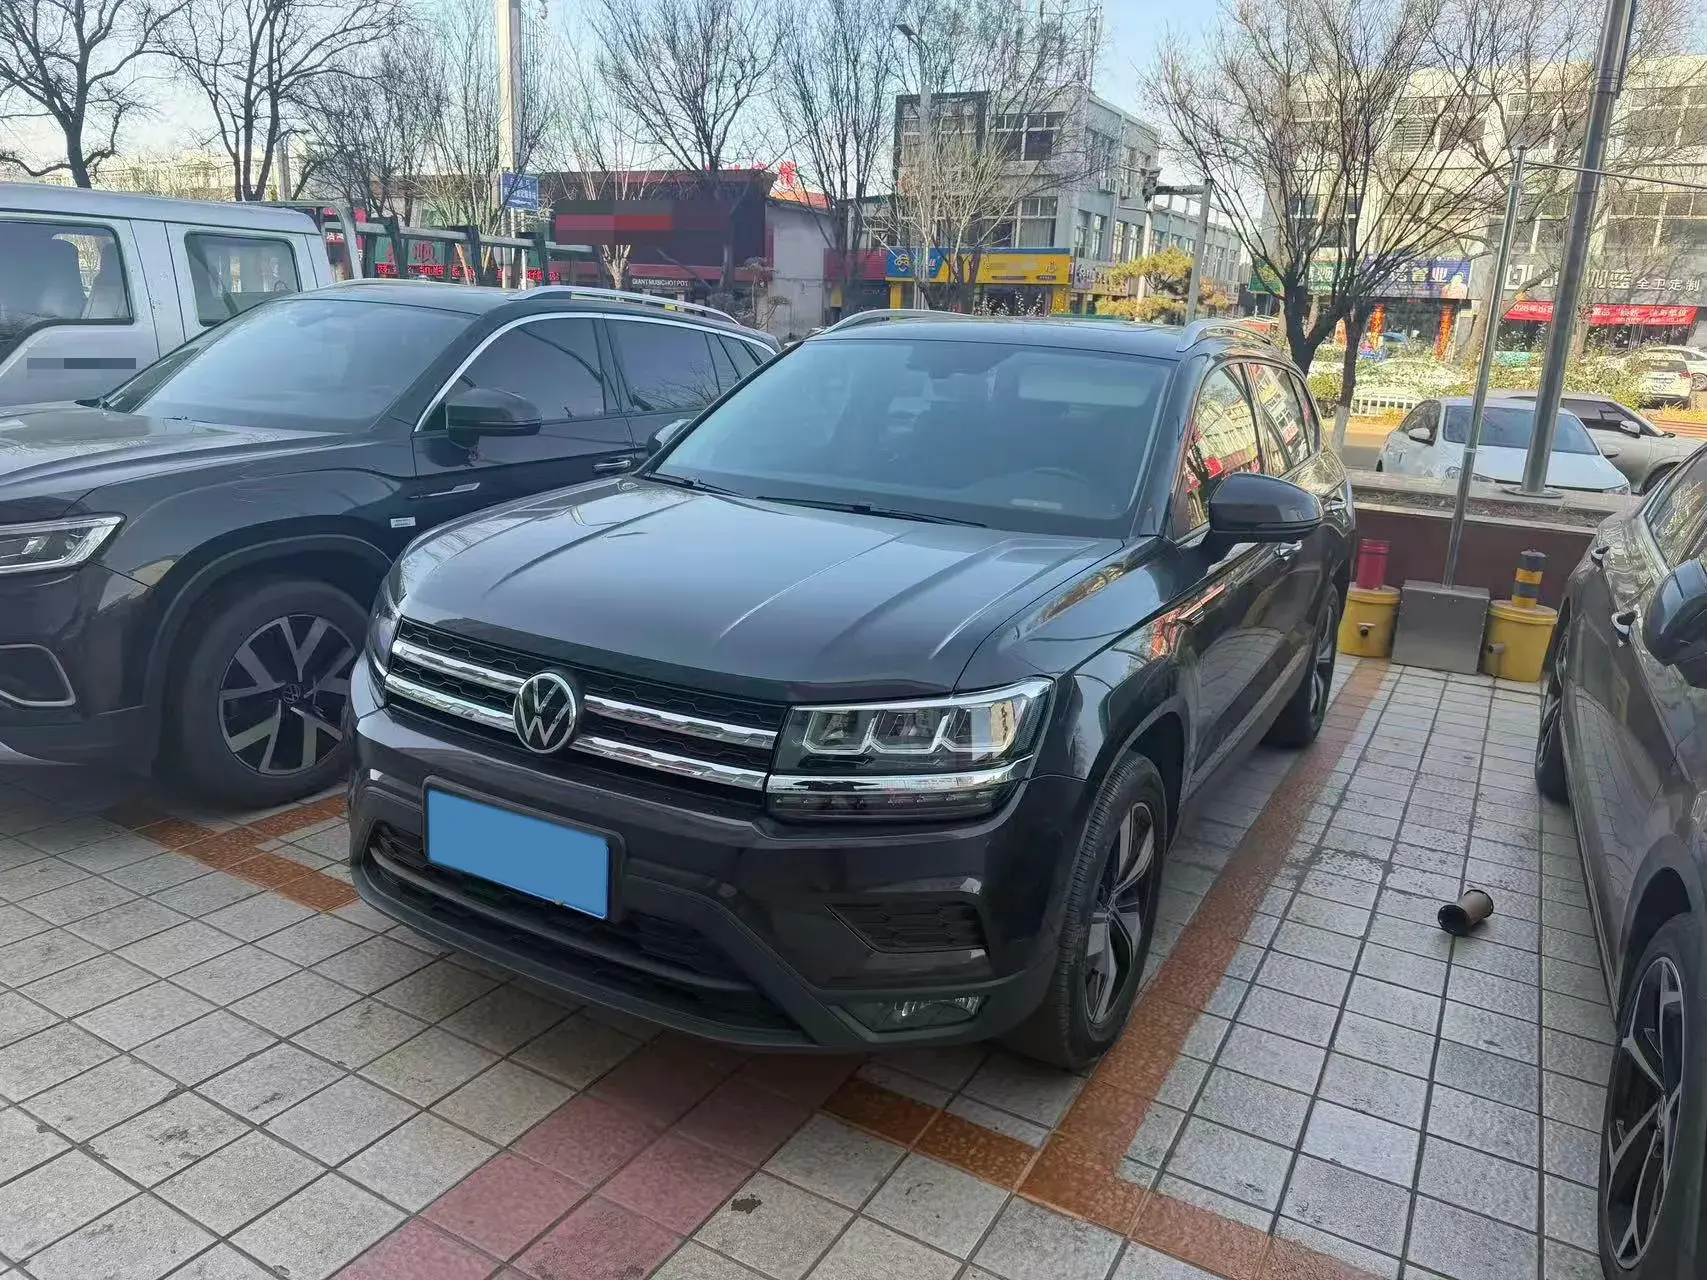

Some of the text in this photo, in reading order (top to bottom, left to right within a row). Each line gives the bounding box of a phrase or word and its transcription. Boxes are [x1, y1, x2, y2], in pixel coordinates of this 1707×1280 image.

[632, 278, 648, 286] GIANT
[1635, 277, 1702, 292] 全卫定制
